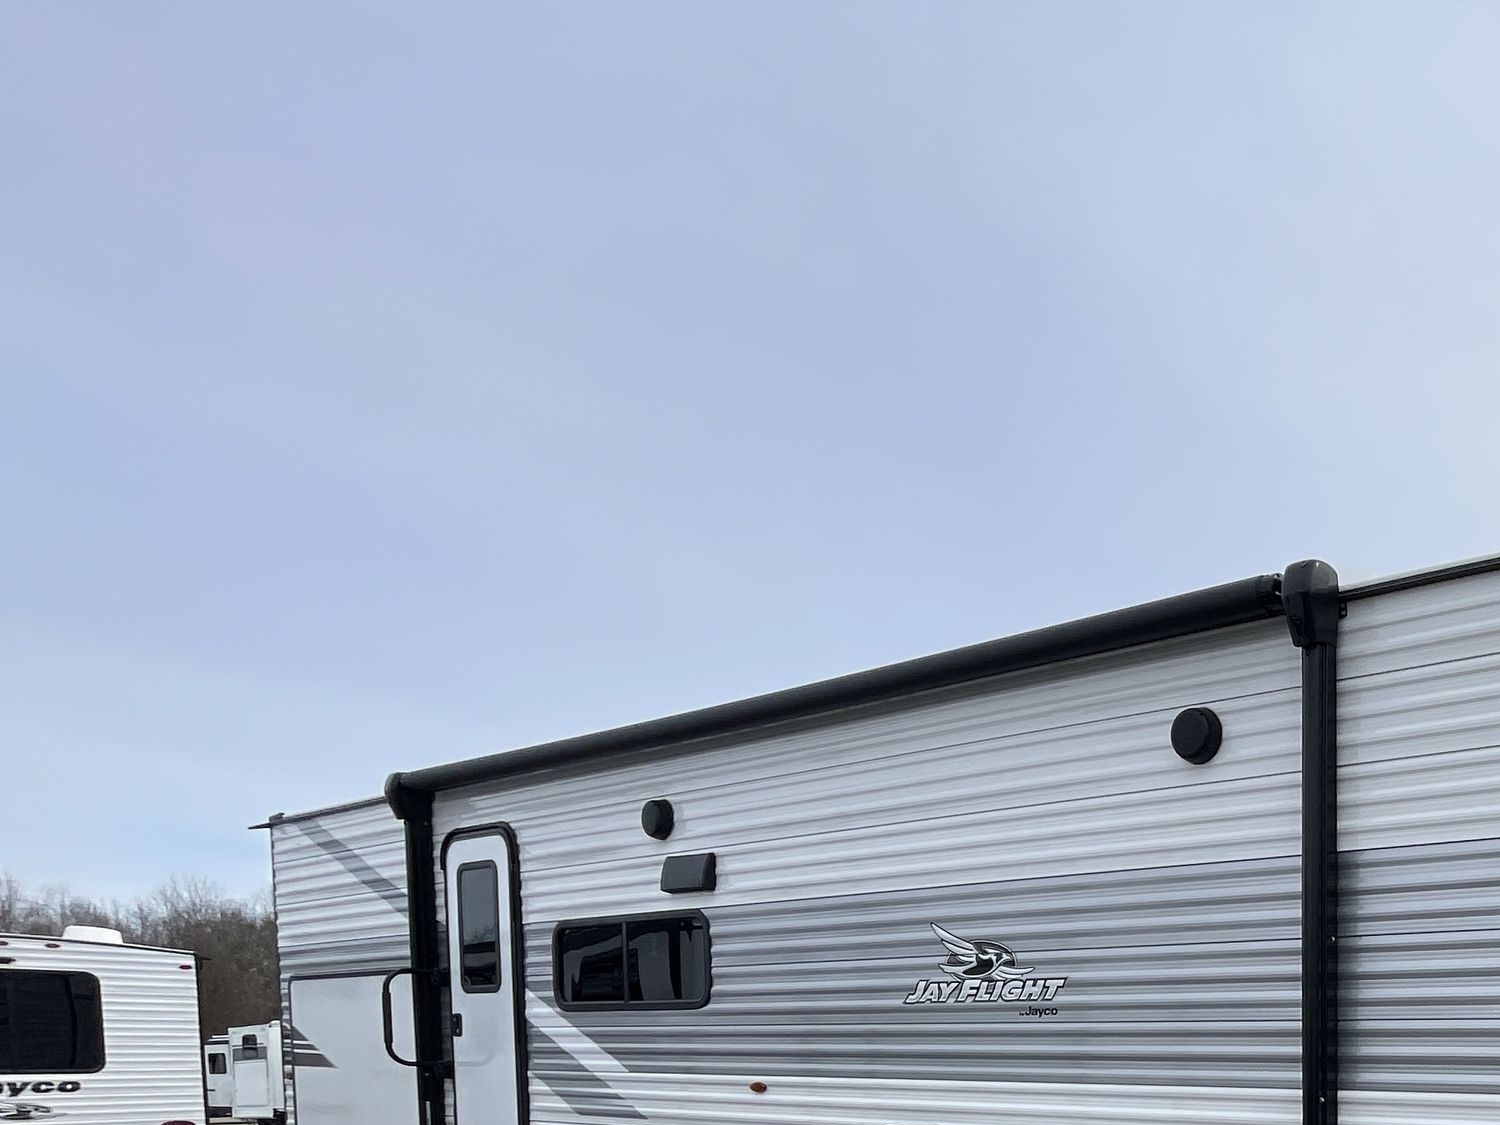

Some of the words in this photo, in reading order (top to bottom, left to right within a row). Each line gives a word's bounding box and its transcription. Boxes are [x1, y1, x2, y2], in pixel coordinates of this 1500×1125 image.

[904, 979, 959, 1004] JAY
[955, 976, 1069, 1003] FLIGHT
[1025, 1006, 1058, 1018] Jayco
[0, 1081, 81, 1097] yco
